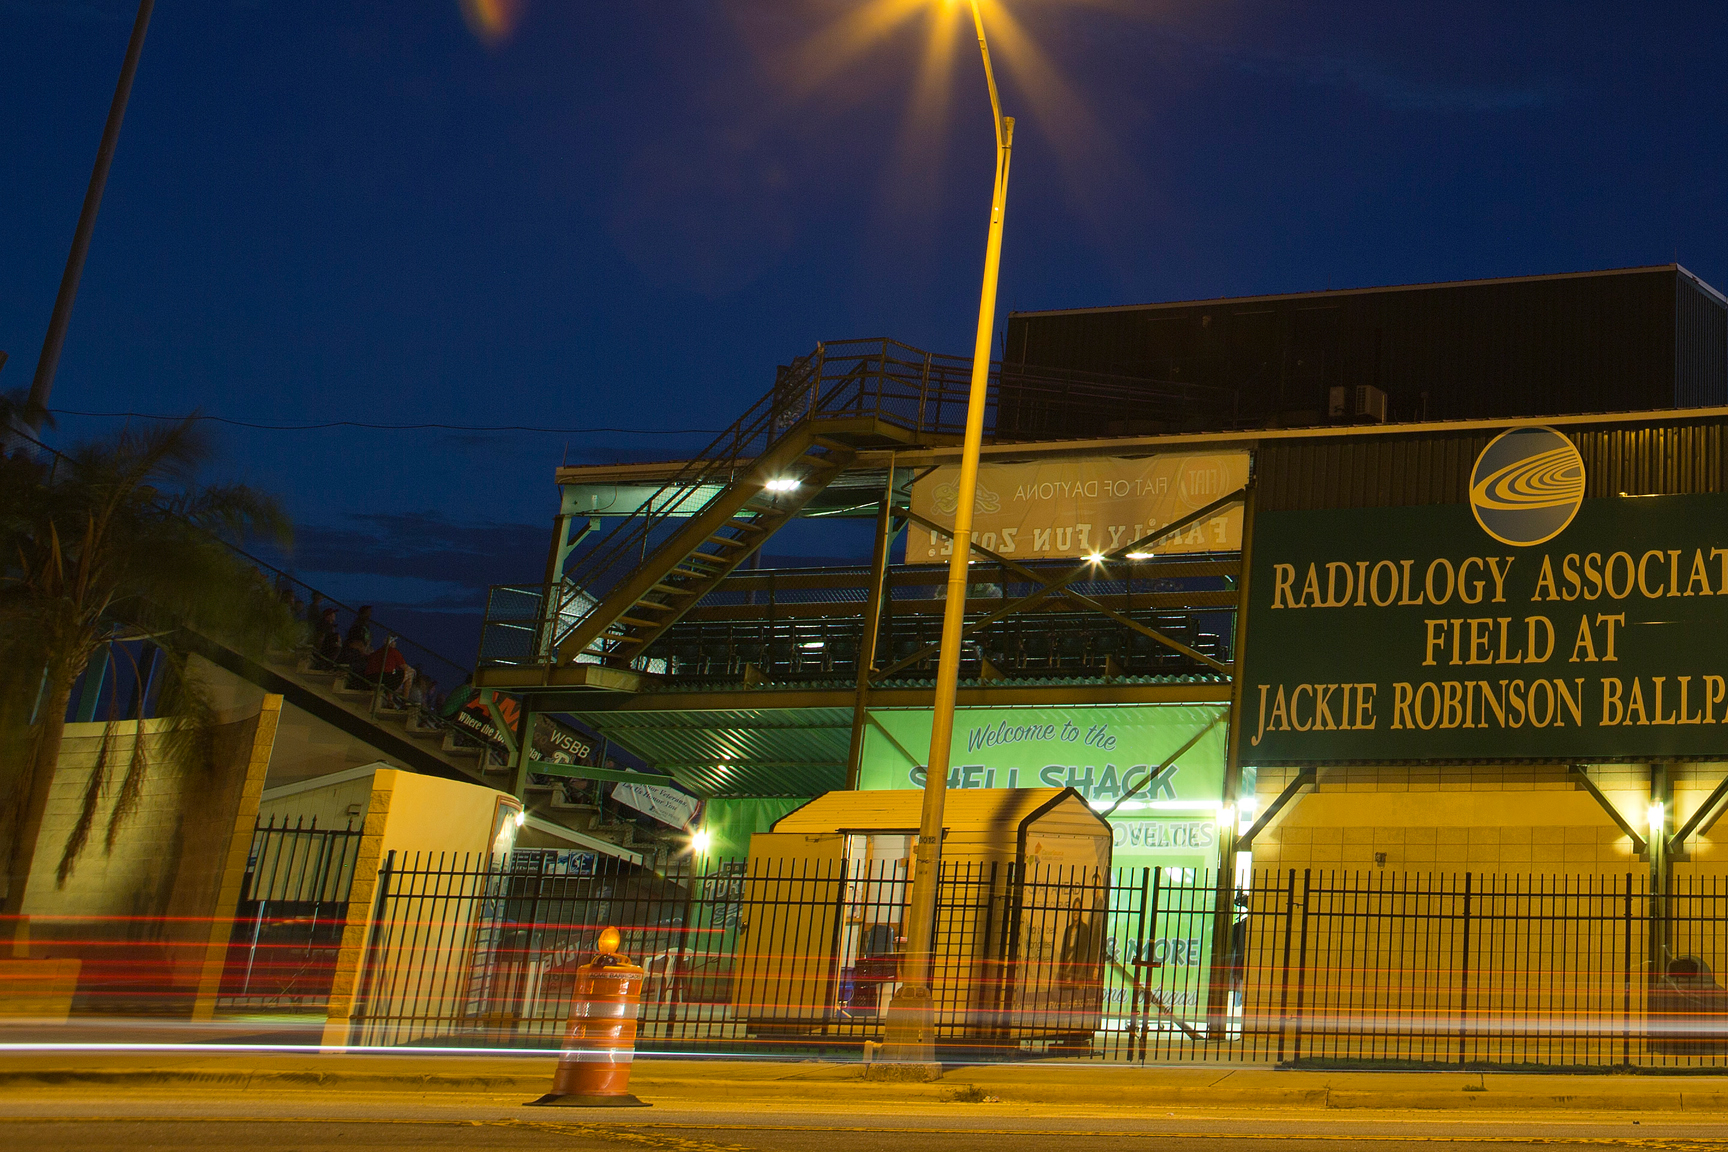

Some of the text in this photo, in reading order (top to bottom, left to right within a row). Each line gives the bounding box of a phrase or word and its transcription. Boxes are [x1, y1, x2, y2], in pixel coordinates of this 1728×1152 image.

[1270, 556, 1516, 609] RADIOLOGY
[1422, 611, 1625, 666] FIELD AT
[458, 711, 483, 730] Where
[481, 723, 495, 737] the
[1251, 682, 1377, 747] JACKIE
[1390, 678, 1585, 730] ROBINSON
[550, 729, 591, 759] WSBB
[968, 719, 1118, 754] Welcome to the
[1038, 763, 1179, 802] SHACK
[664, 800, 678, 812] You
[1112, 821, 1213, 848] OVELTIES
[1127, 937, 1200, 966] MORE
